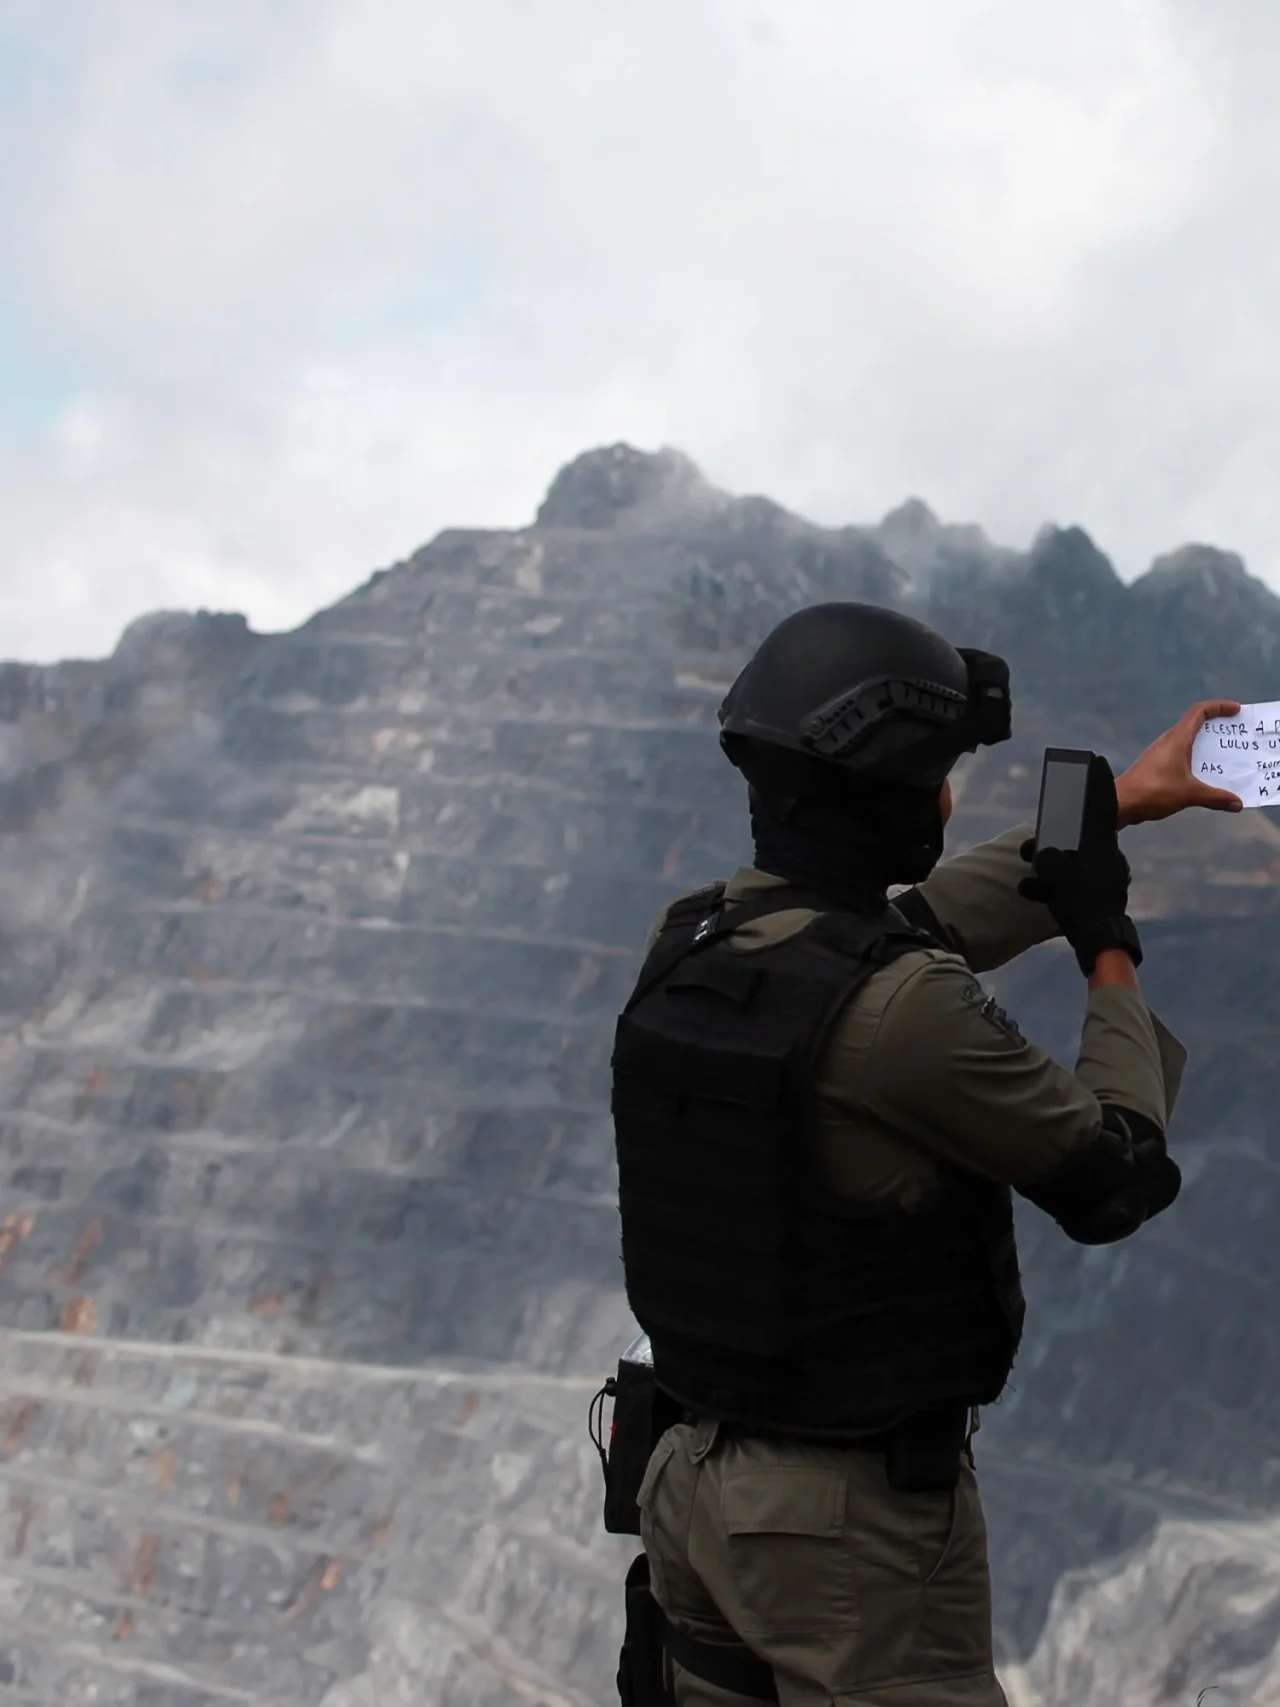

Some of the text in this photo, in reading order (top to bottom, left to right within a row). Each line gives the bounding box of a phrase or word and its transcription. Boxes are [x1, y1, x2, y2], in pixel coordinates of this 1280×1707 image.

[1219, 738, 1259, 750] LULUS
[1200, 761, 1223, 774] AAS
[1259, 786, 1269, 796] K
